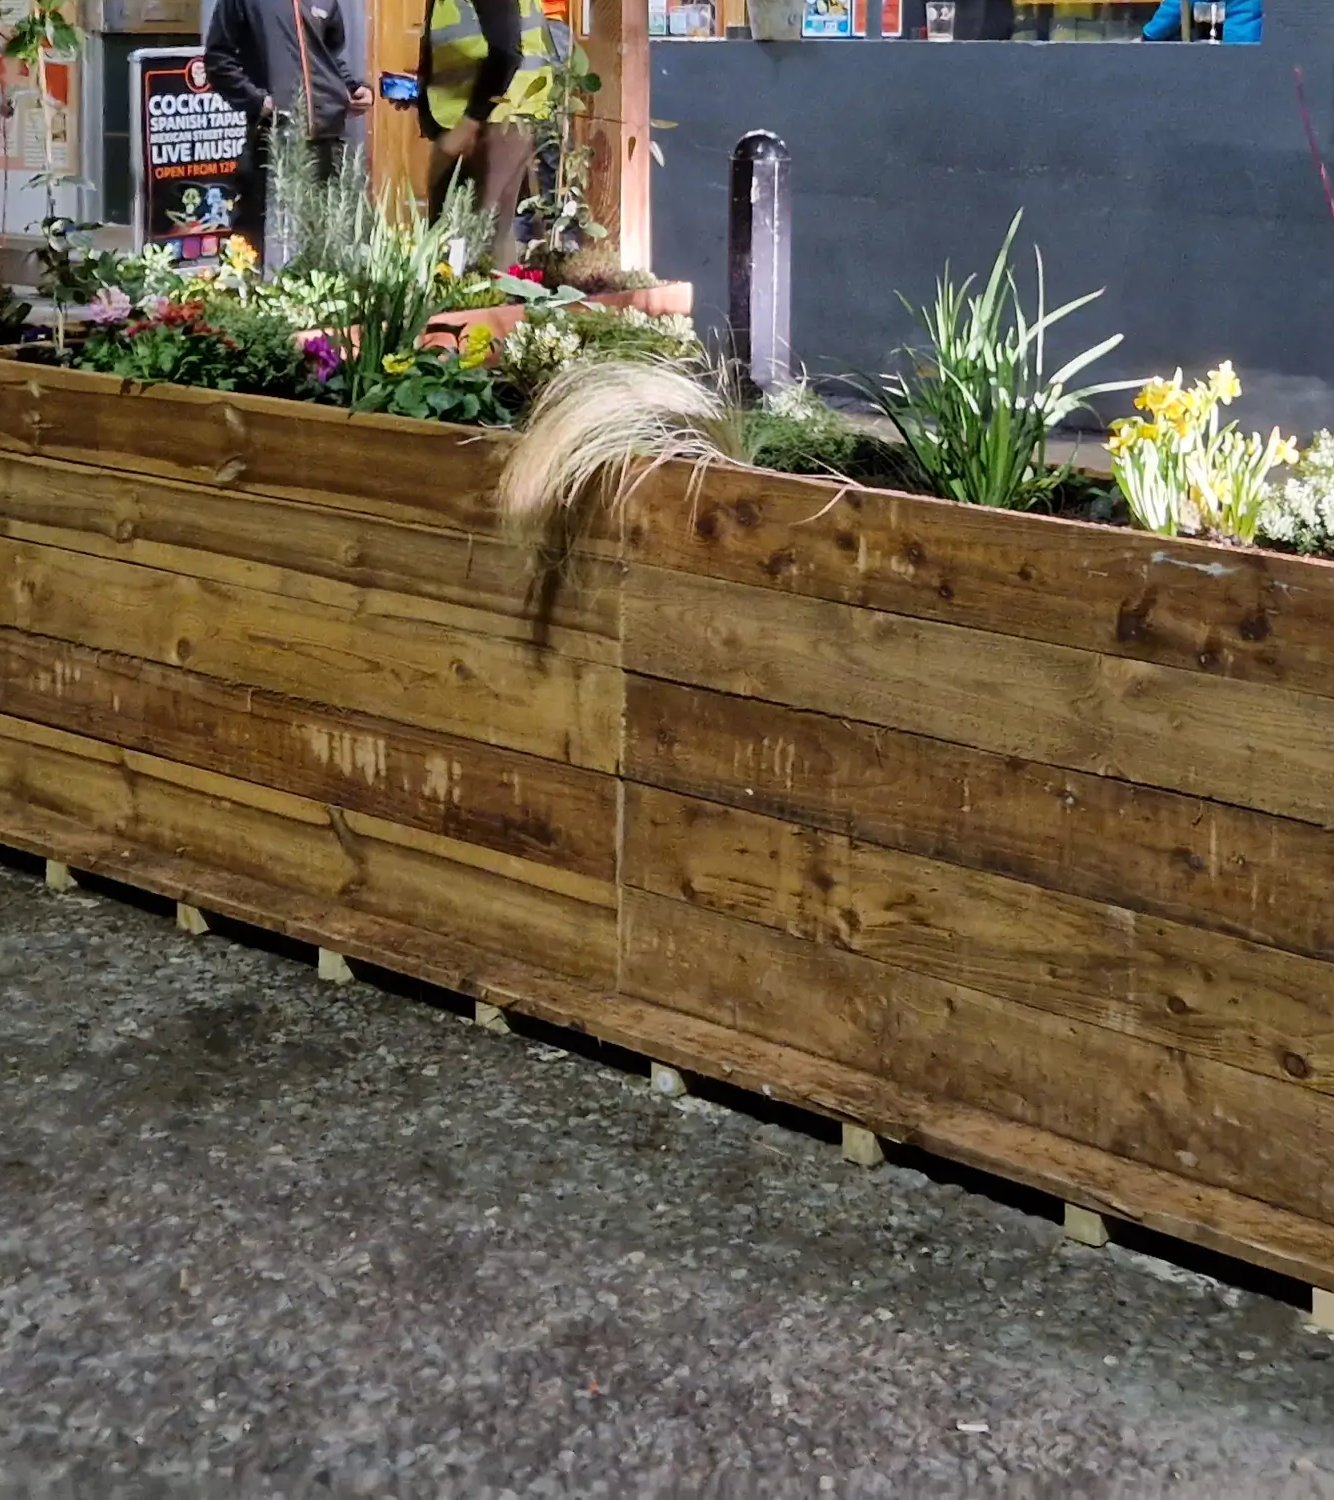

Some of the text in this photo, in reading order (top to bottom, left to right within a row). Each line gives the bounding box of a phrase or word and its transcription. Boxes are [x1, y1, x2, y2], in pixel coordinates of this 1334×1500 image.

[149, 92, 233, 117] COCKTA
[150, 111, 247, 132] SPANISH TAPAS
[192, 128, 223, 142] STREET
[152, 142, 192, 165] LIVE
[155, 165, 185, 180] OPEN
[187, 162, 218, 177] FROM
